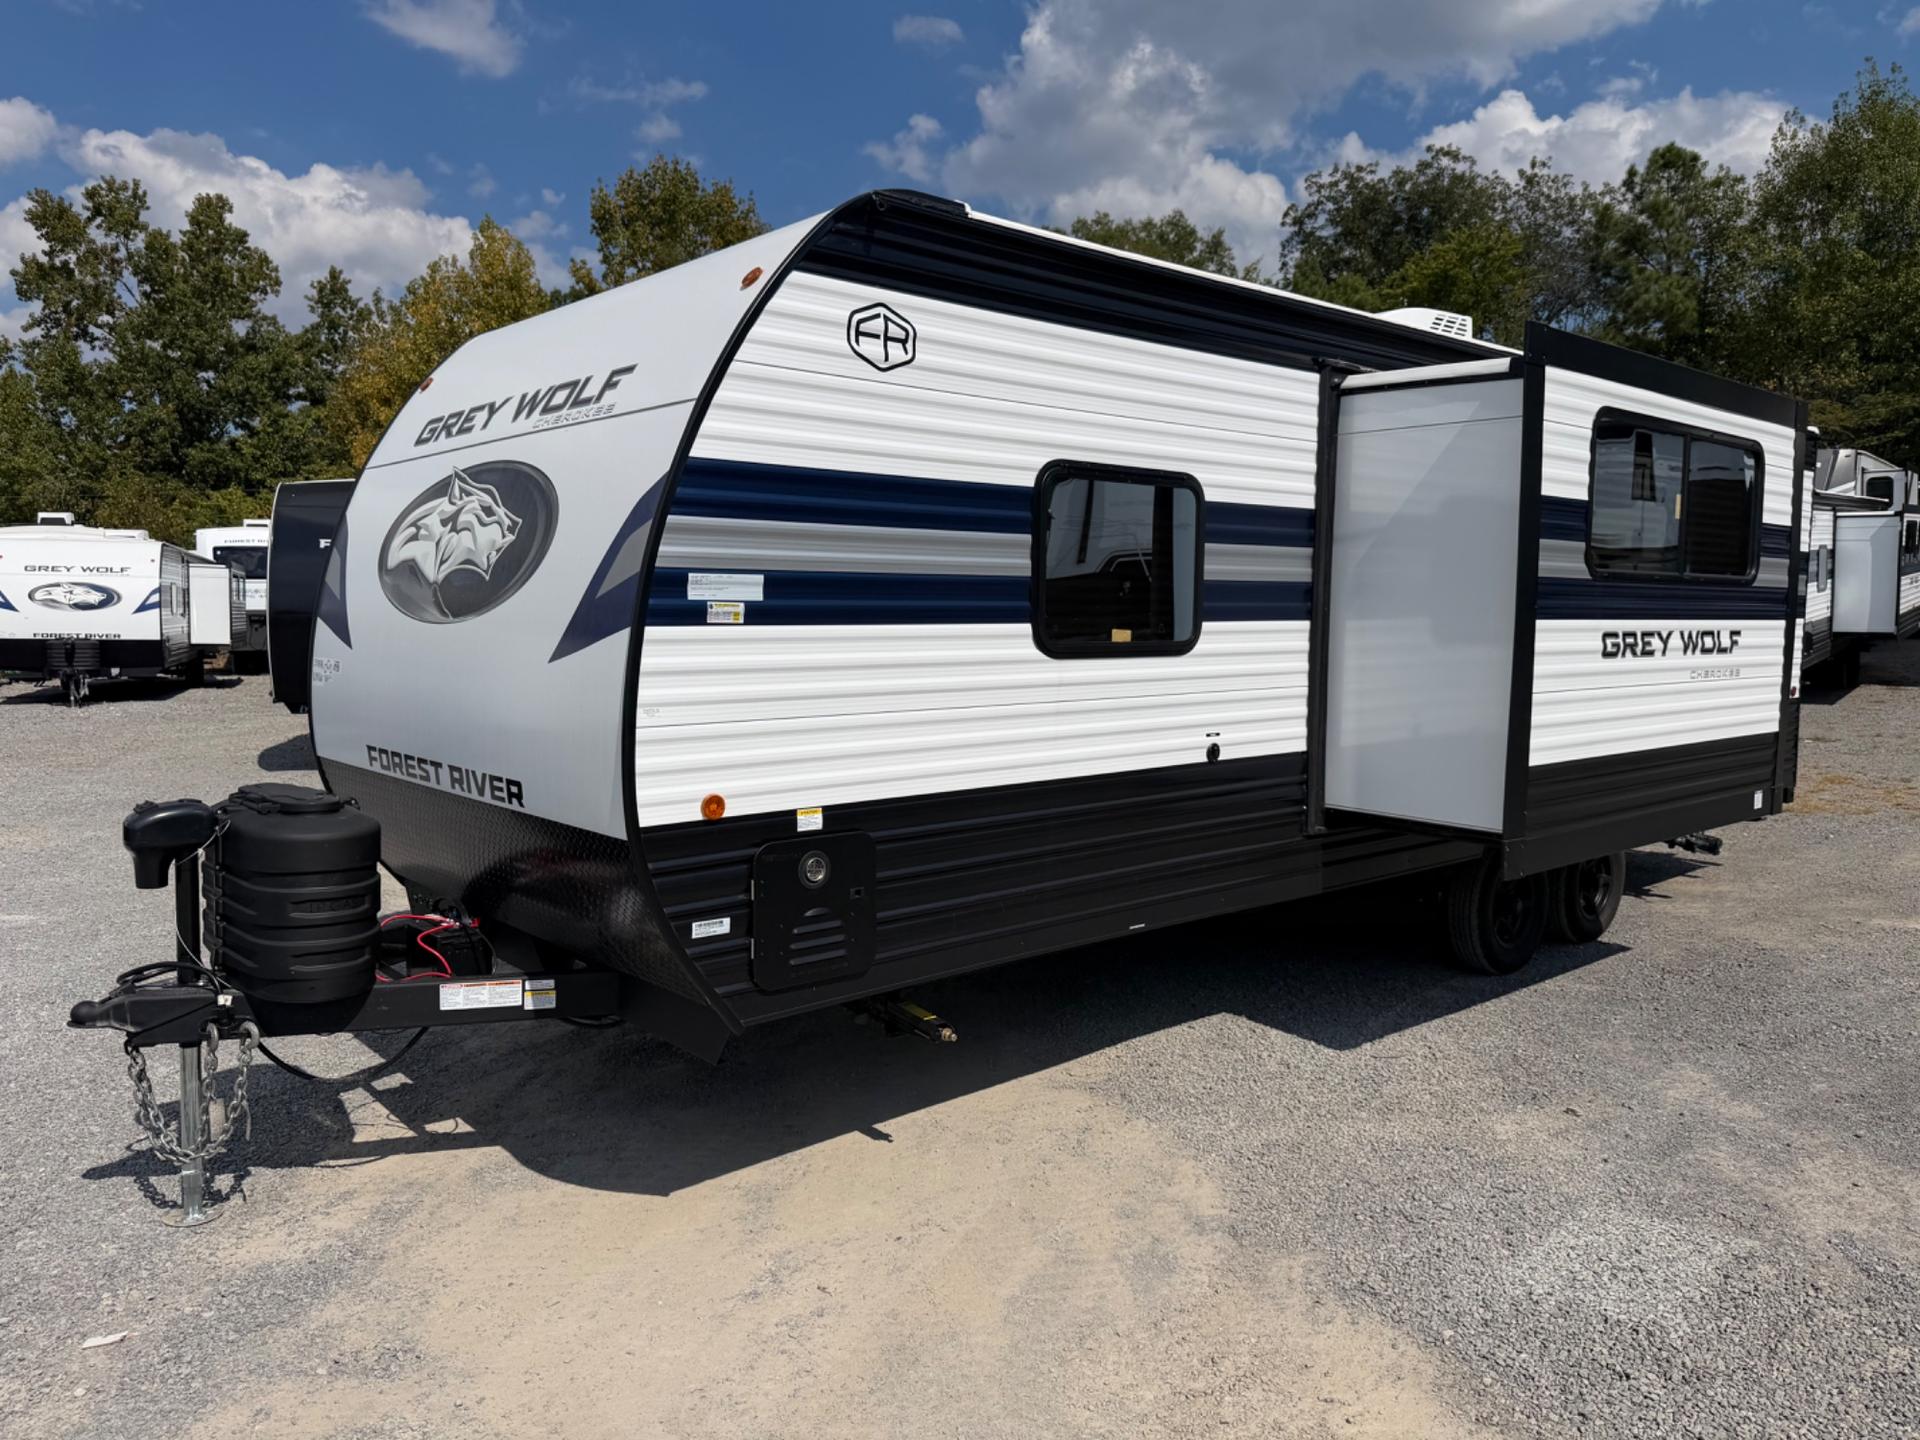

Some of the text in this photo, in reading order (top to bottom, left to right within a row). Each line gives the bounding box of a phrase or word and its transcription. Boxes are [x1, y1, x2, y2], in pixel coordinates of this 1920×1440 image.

[413, 363, 639, 447] GREY WOLF
[532, 402, 616, 429] CHEROKEE
[24, 565, 132, 574] GREY WOLF
[32, 632, 122, 640] FOREST RIVER
[1601, 629, 1742, 659] GREY WOLF
[1689, 668, 1741, 680] CHEROKEE
[366, 744, 525, 808] FOREST RIVER
